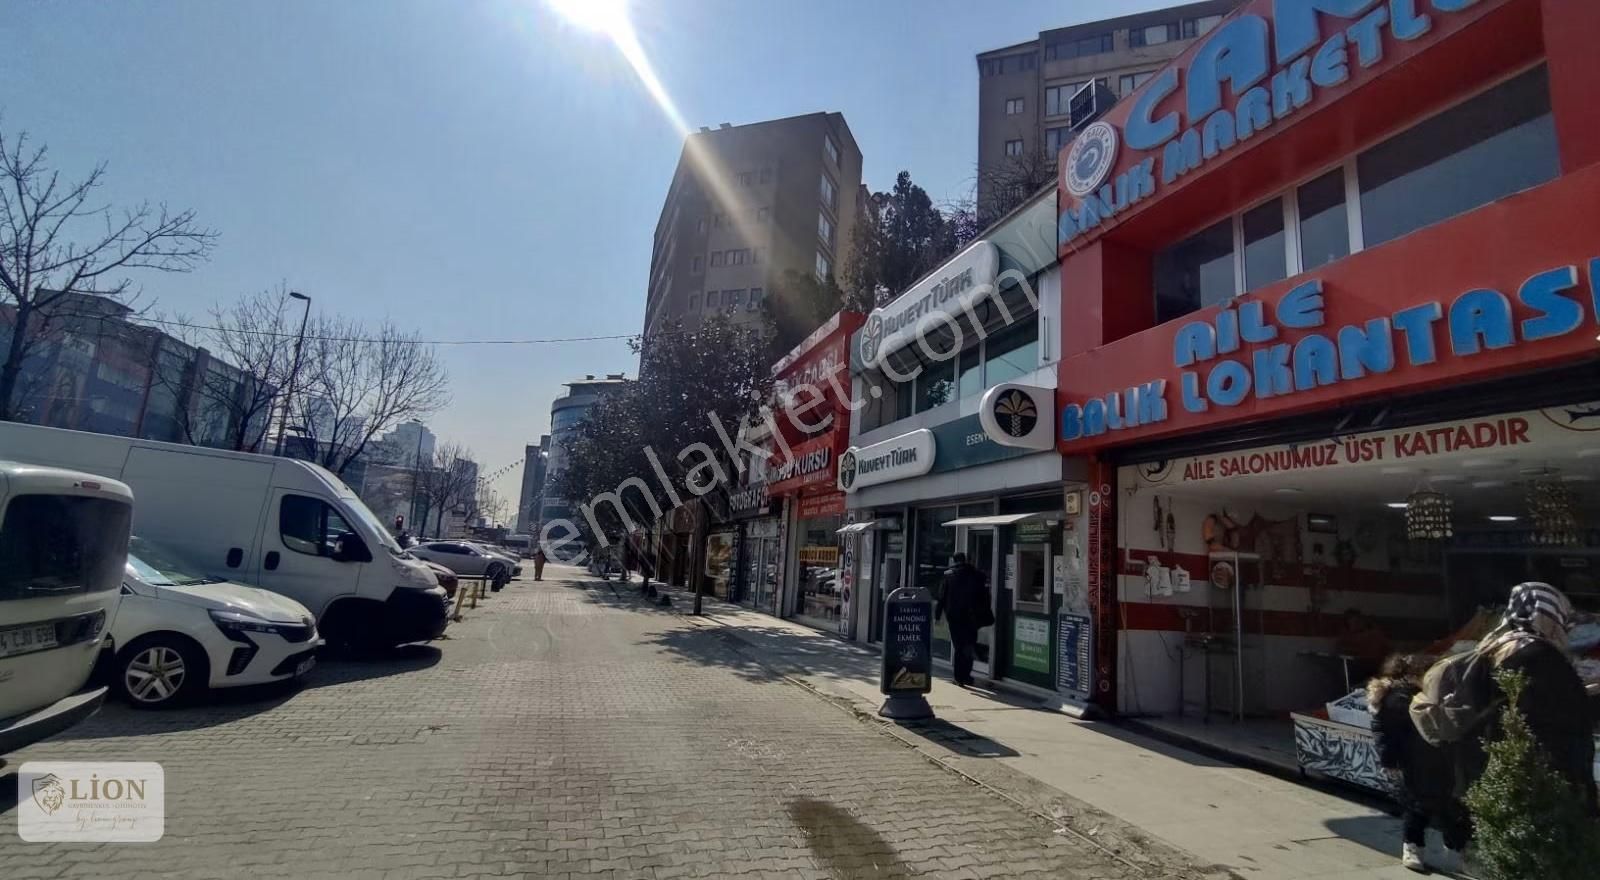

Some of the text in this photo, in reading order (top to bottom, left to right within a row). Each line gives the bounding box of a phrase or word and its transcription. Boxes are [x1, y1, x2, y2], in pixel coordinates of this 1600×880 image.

[1058, 0, 1482, 240] BALIK MARKETL
[1173, 279, 1324, 367] AİLE
[966, 431, 991, 446] ESENY
[1062, 379, 1168, 442] BALIK
[1183, 417, 1531, 481] AİLE SALONUMUZ ÜST KATTADIR
